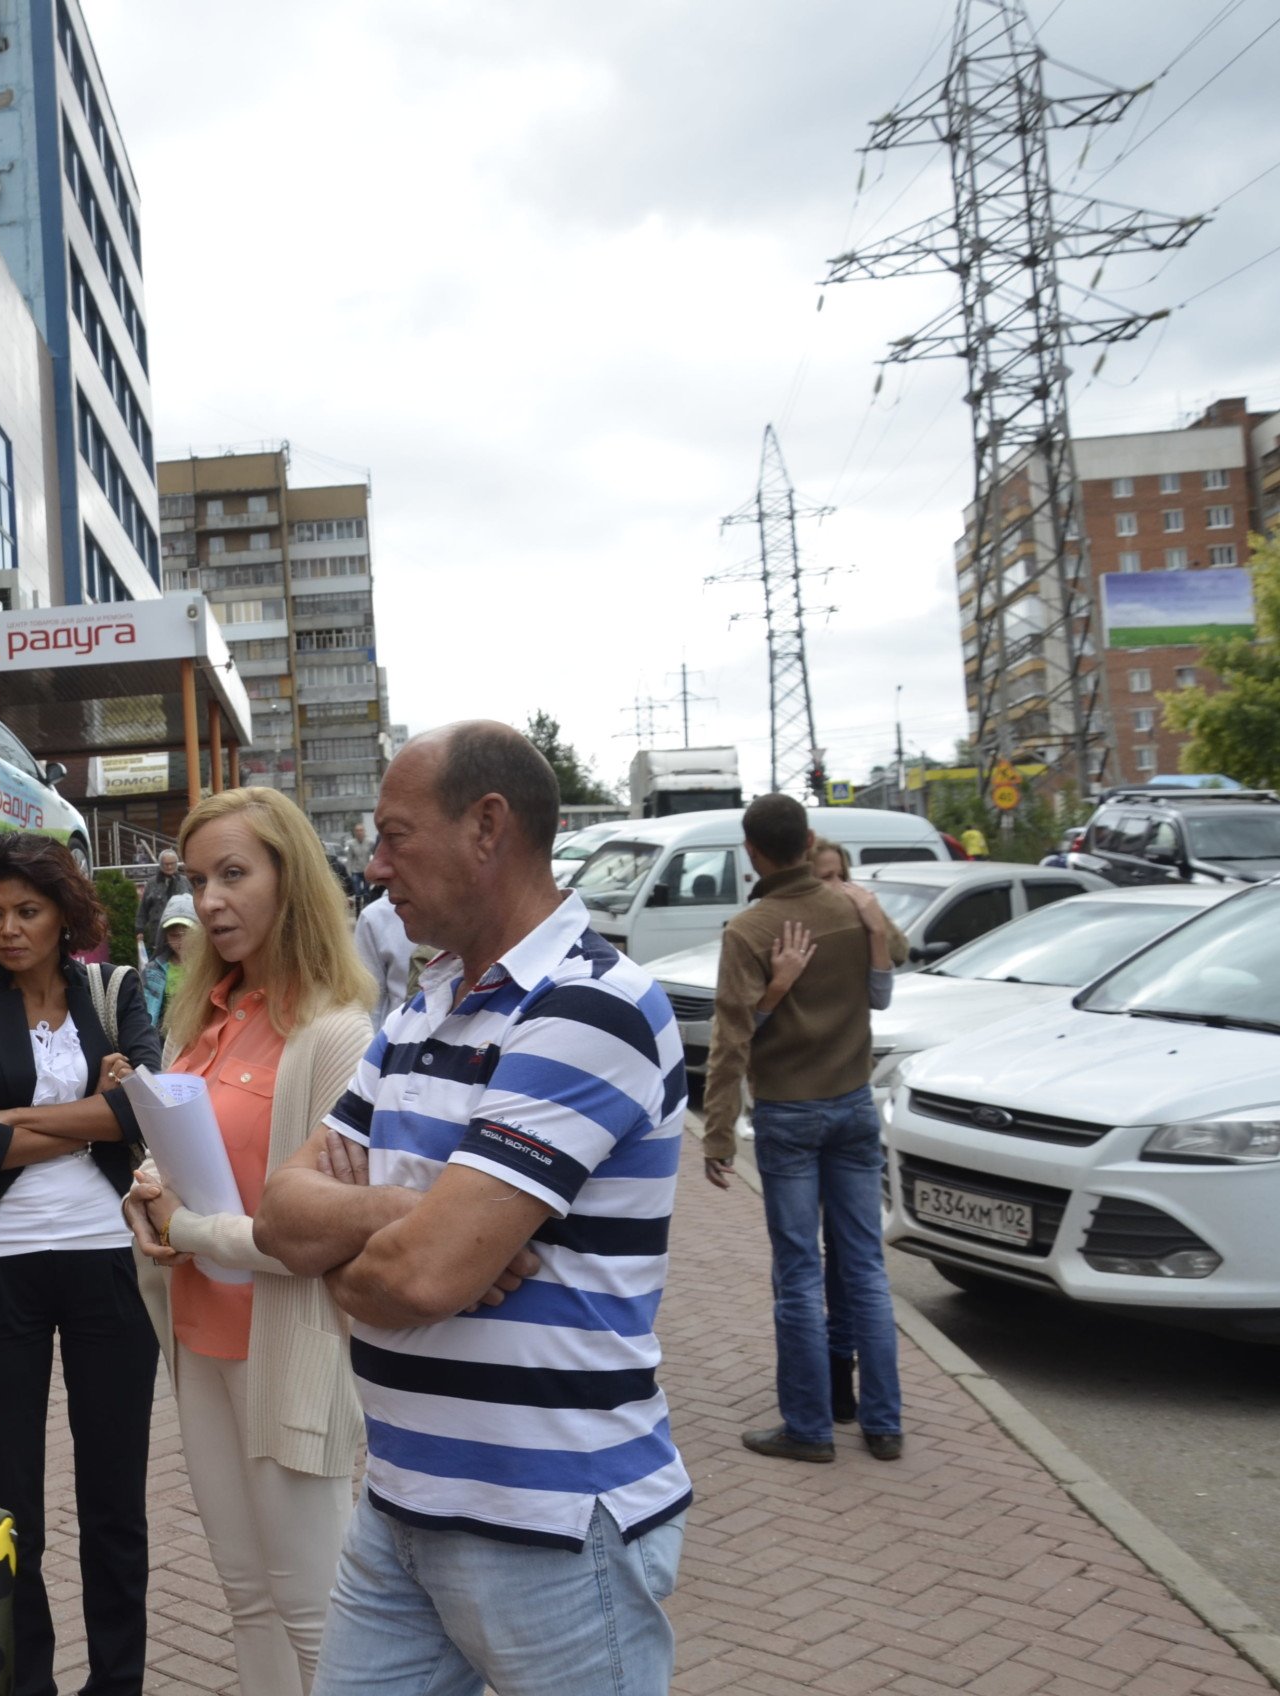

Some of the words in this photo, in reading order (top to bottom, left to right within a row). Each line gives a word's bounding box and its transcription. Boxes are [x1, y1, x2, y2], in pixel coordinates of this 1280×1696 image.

[61, 617, 74, 625] ДЛЯ
[76, 616, 95, 624] ДОМА
[103, 613, 134, 621] РЕМОНТА
[7, 623, 136, 660] радуга
[480, 1128, 503, 1142] ROYAL
[504, 1138, 531, 1154] YACHT
[530, 1149, 553, 1166] CLUB
[995, 1202, 1026, 1228] 102
